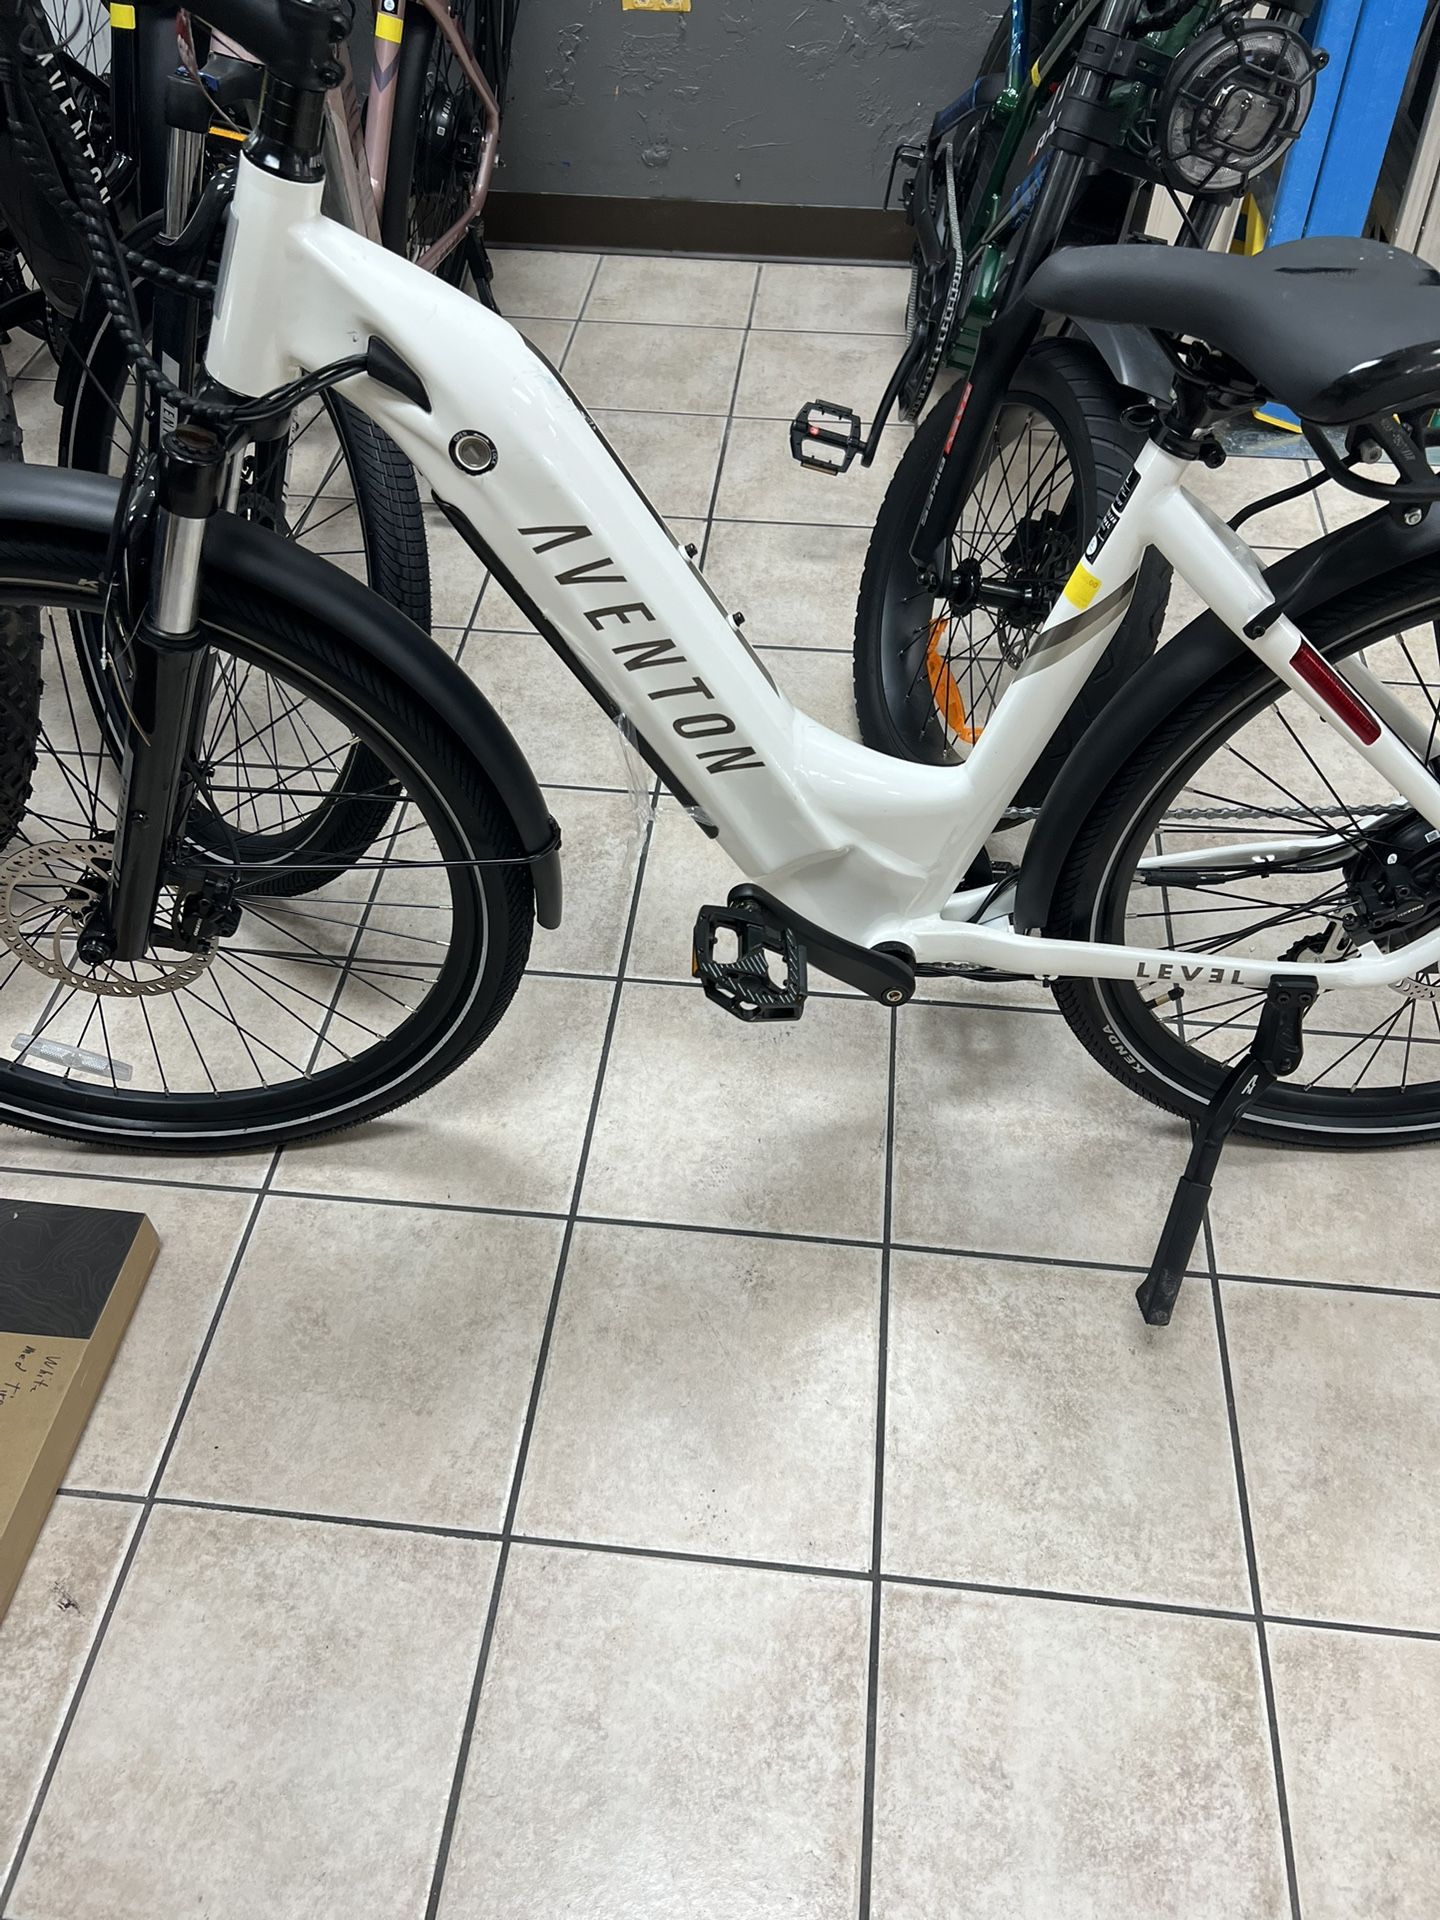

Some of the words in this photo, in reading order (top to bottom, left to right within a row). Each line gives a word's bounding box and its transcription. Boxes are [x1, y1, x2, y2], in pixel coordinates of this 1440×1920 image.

[517, 525, 766, 774] AVENTON
[1136, 962, 1245, 985] LEVEL
[1102, 1024, 1146, 1074] KENDA
